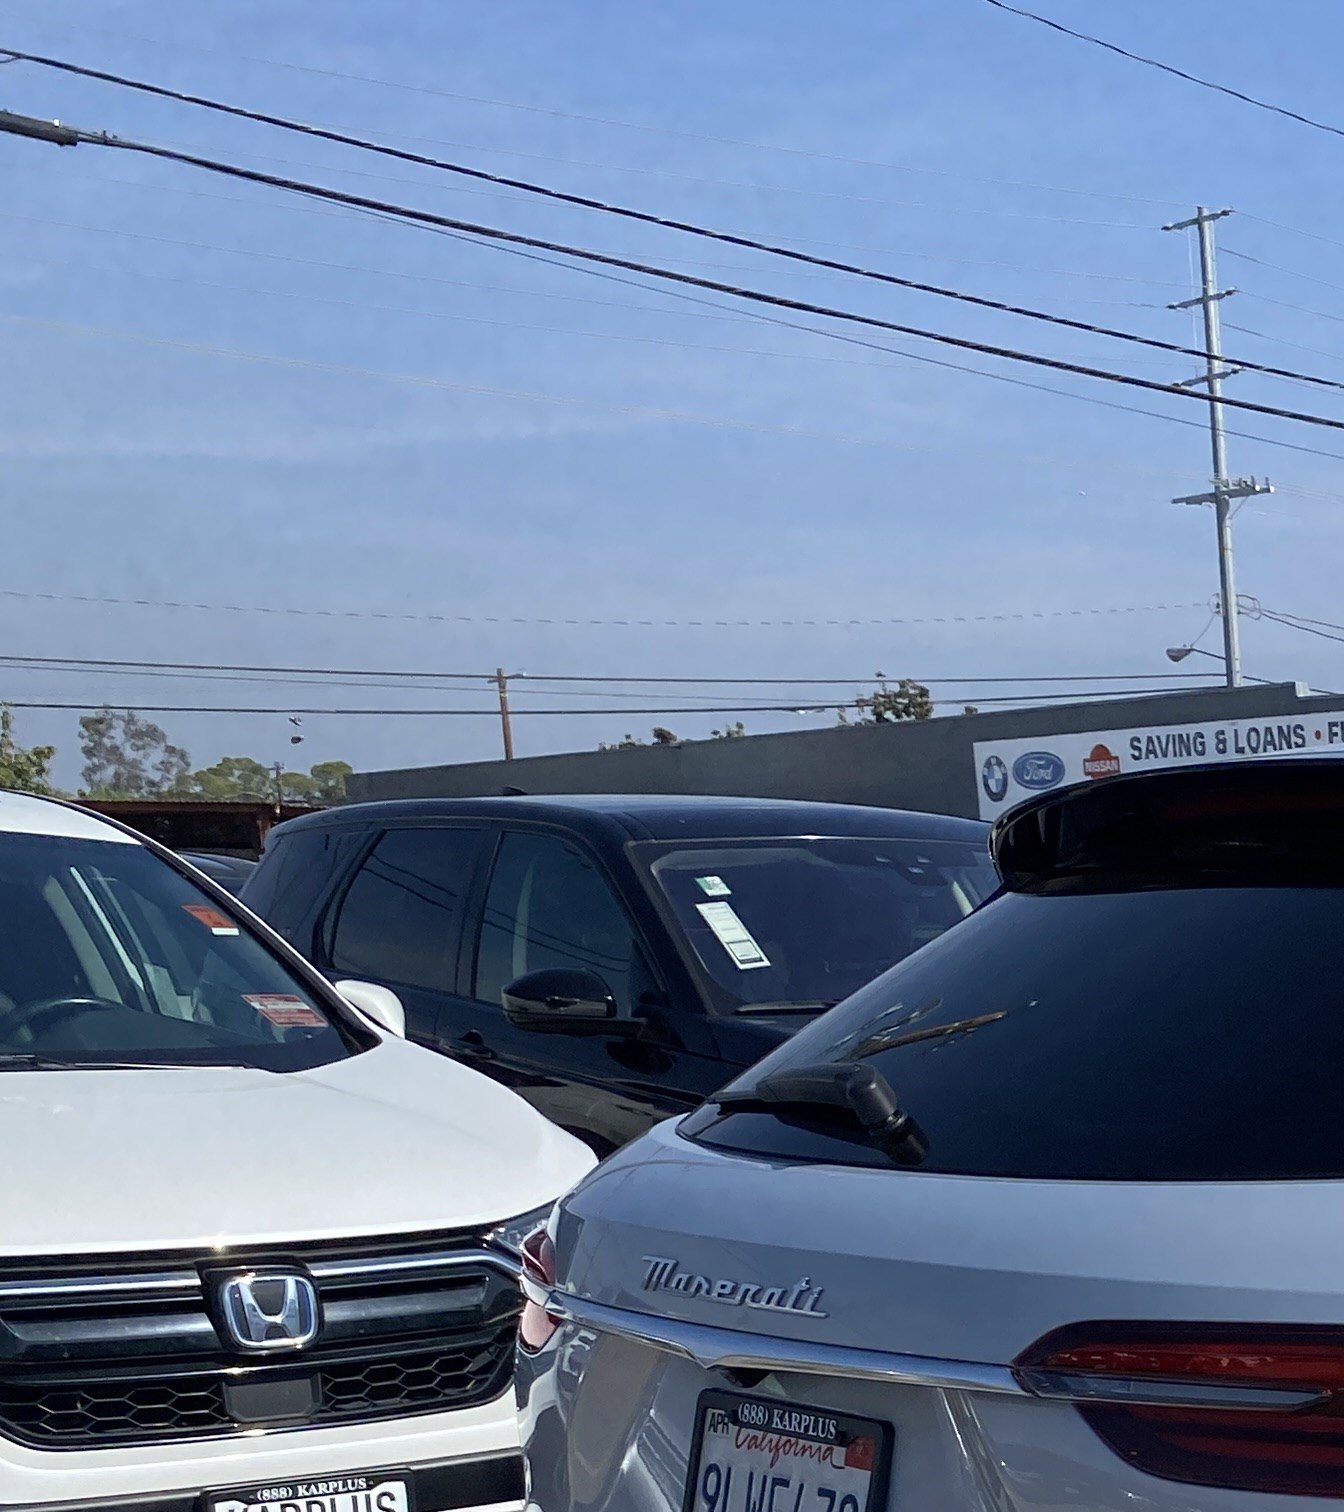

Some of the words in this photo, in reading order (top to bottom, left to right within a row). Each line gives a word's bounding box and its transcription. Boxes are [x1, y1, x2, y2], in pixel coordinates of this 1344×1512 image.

[1129, 731, 1207, 761] SAVING
[1214, 729, 1228, 755] &
[1233, 723, 1306, 754] LOANS
[1085, 759, 1118, 772] NISSAN
[641, 1254, 830, 1319] Maserati
[737, 1402, 770, 1427] (888)
[771, 1407, 837, 1440] KARPLUS
[733, 1427, 846, 1470] California
[256, 1486, 293, 1501] (888)
[297, 1477, 367, 1498] KARPLUS
